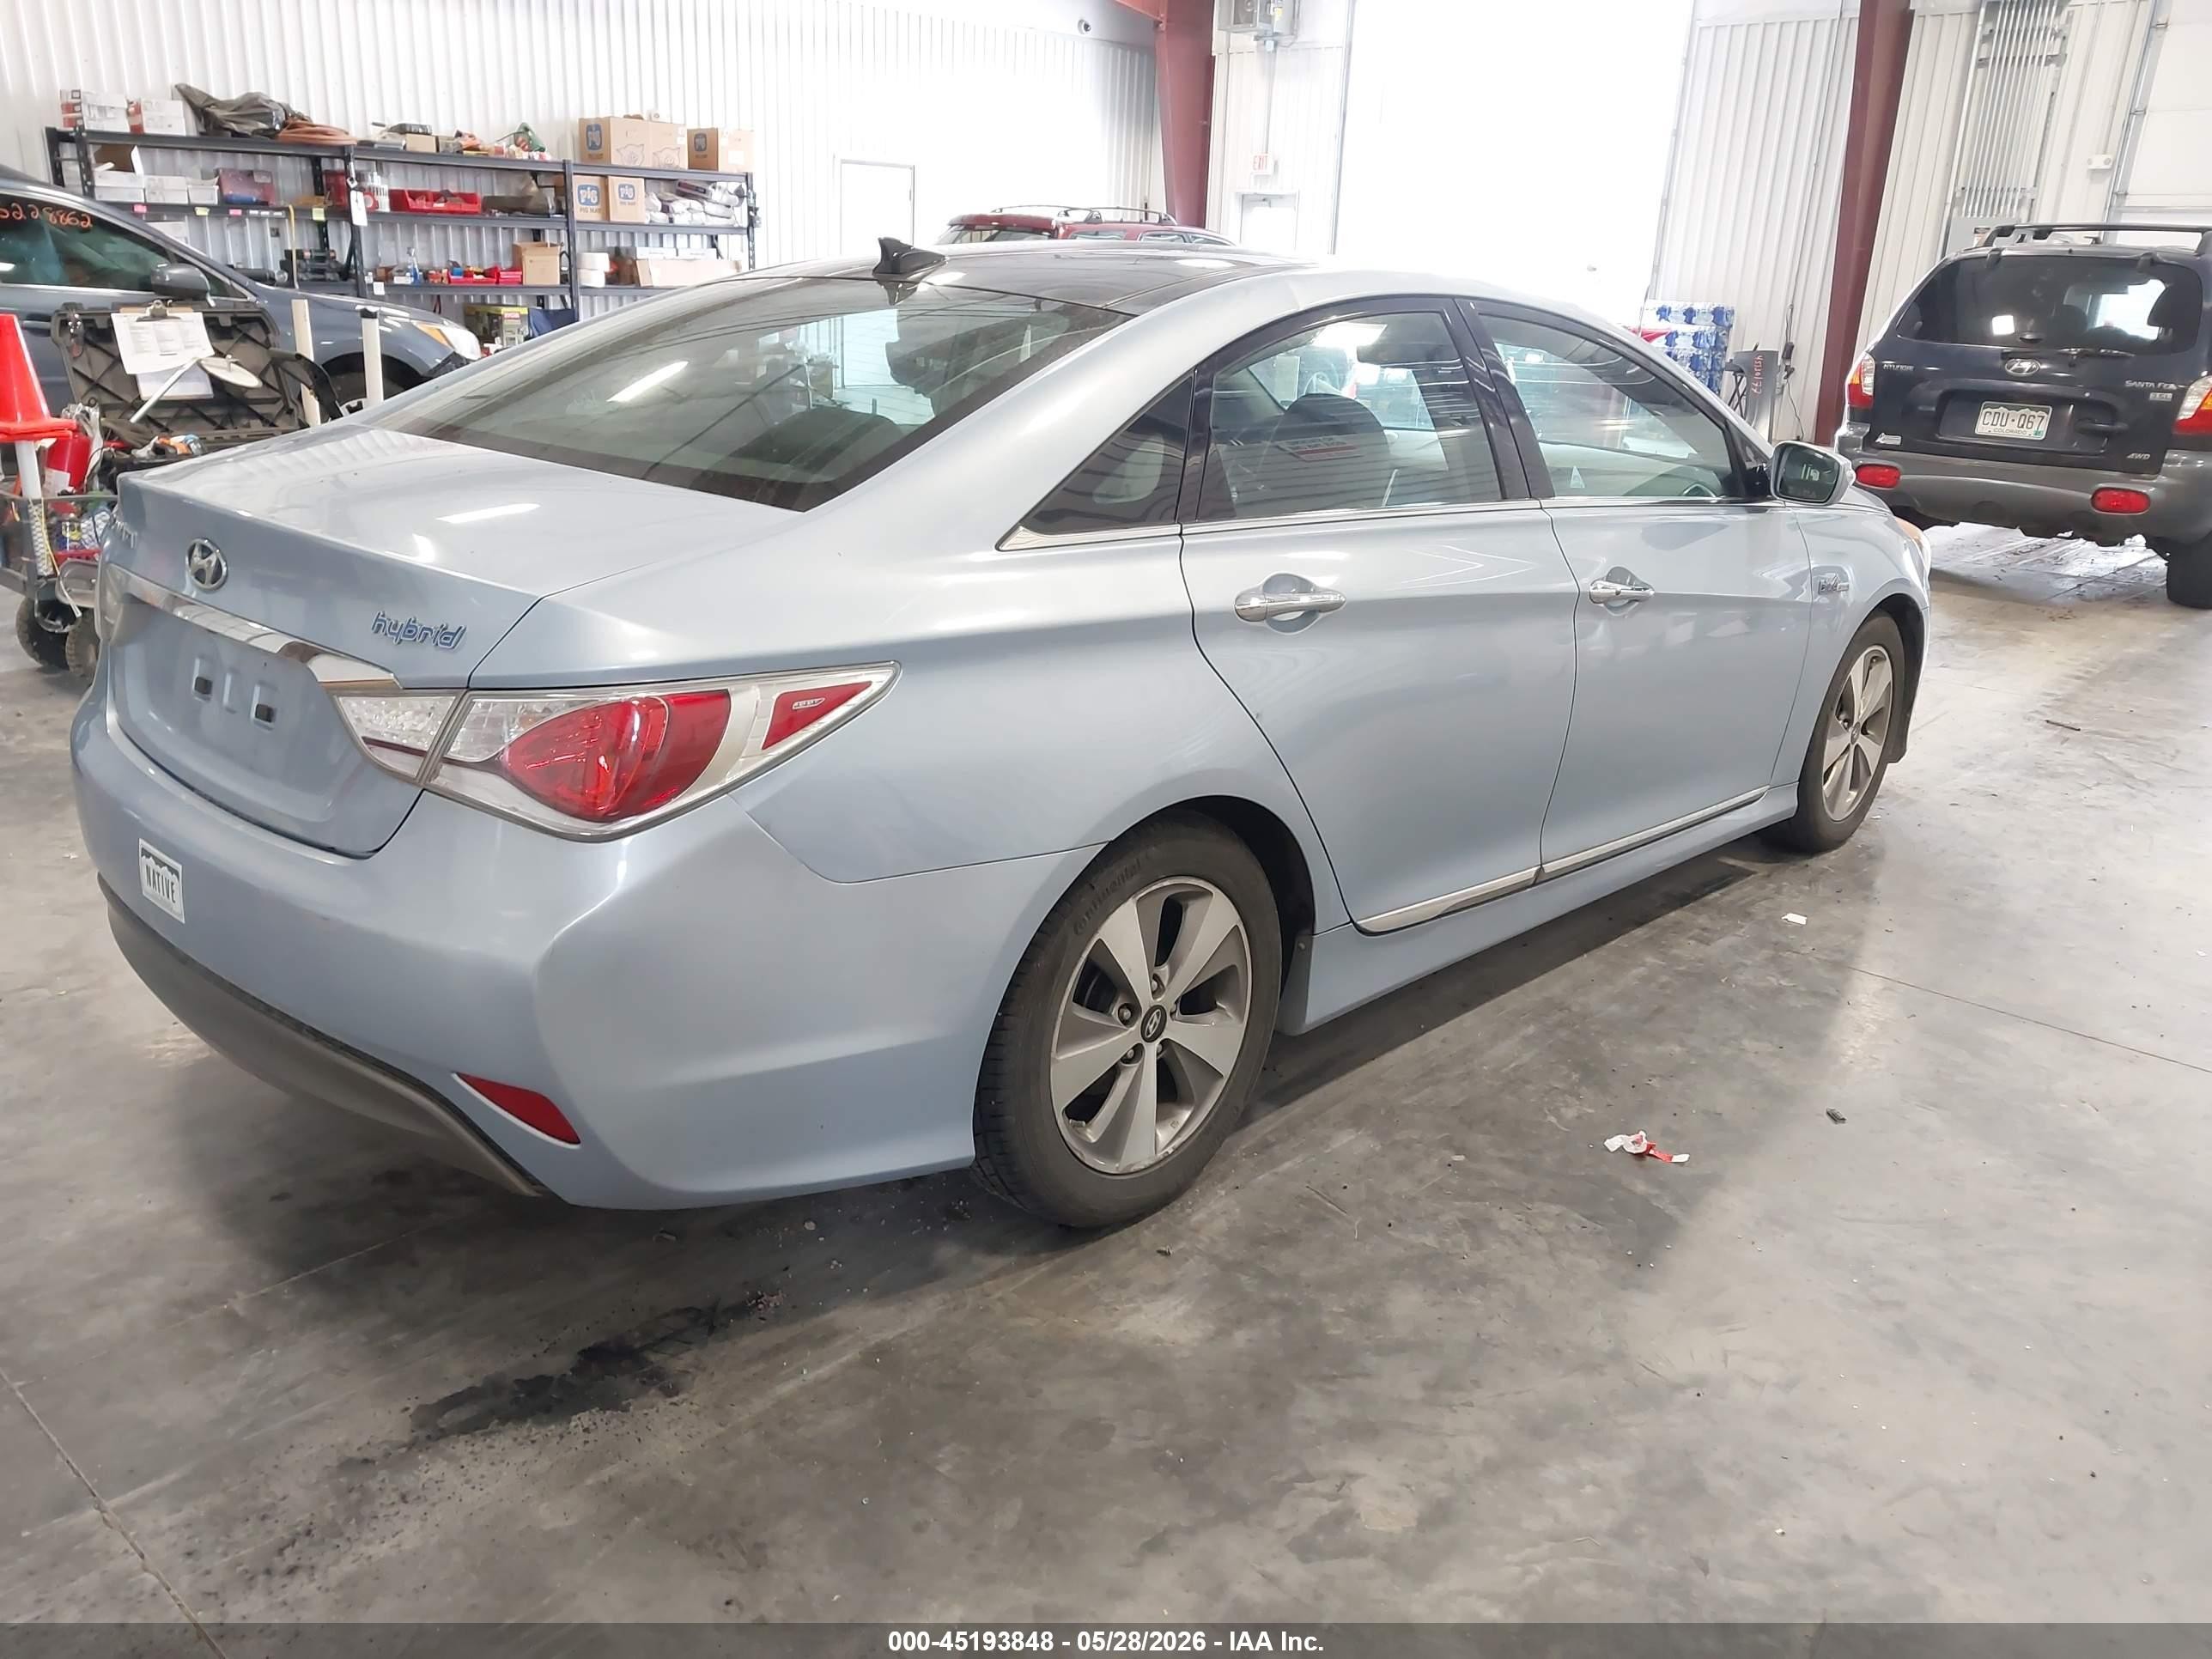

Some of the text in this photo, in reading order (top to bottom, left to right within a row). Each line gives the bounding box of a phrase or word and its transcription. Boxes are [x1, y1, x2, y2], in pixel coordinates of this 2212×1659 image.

[1253, 155, 1268, 170] EXIT
[2125, 380, 2155, 389] SANTA
[371, 611, 467, 650] hybrid
[145, 865, 176, 904] NATIVE
